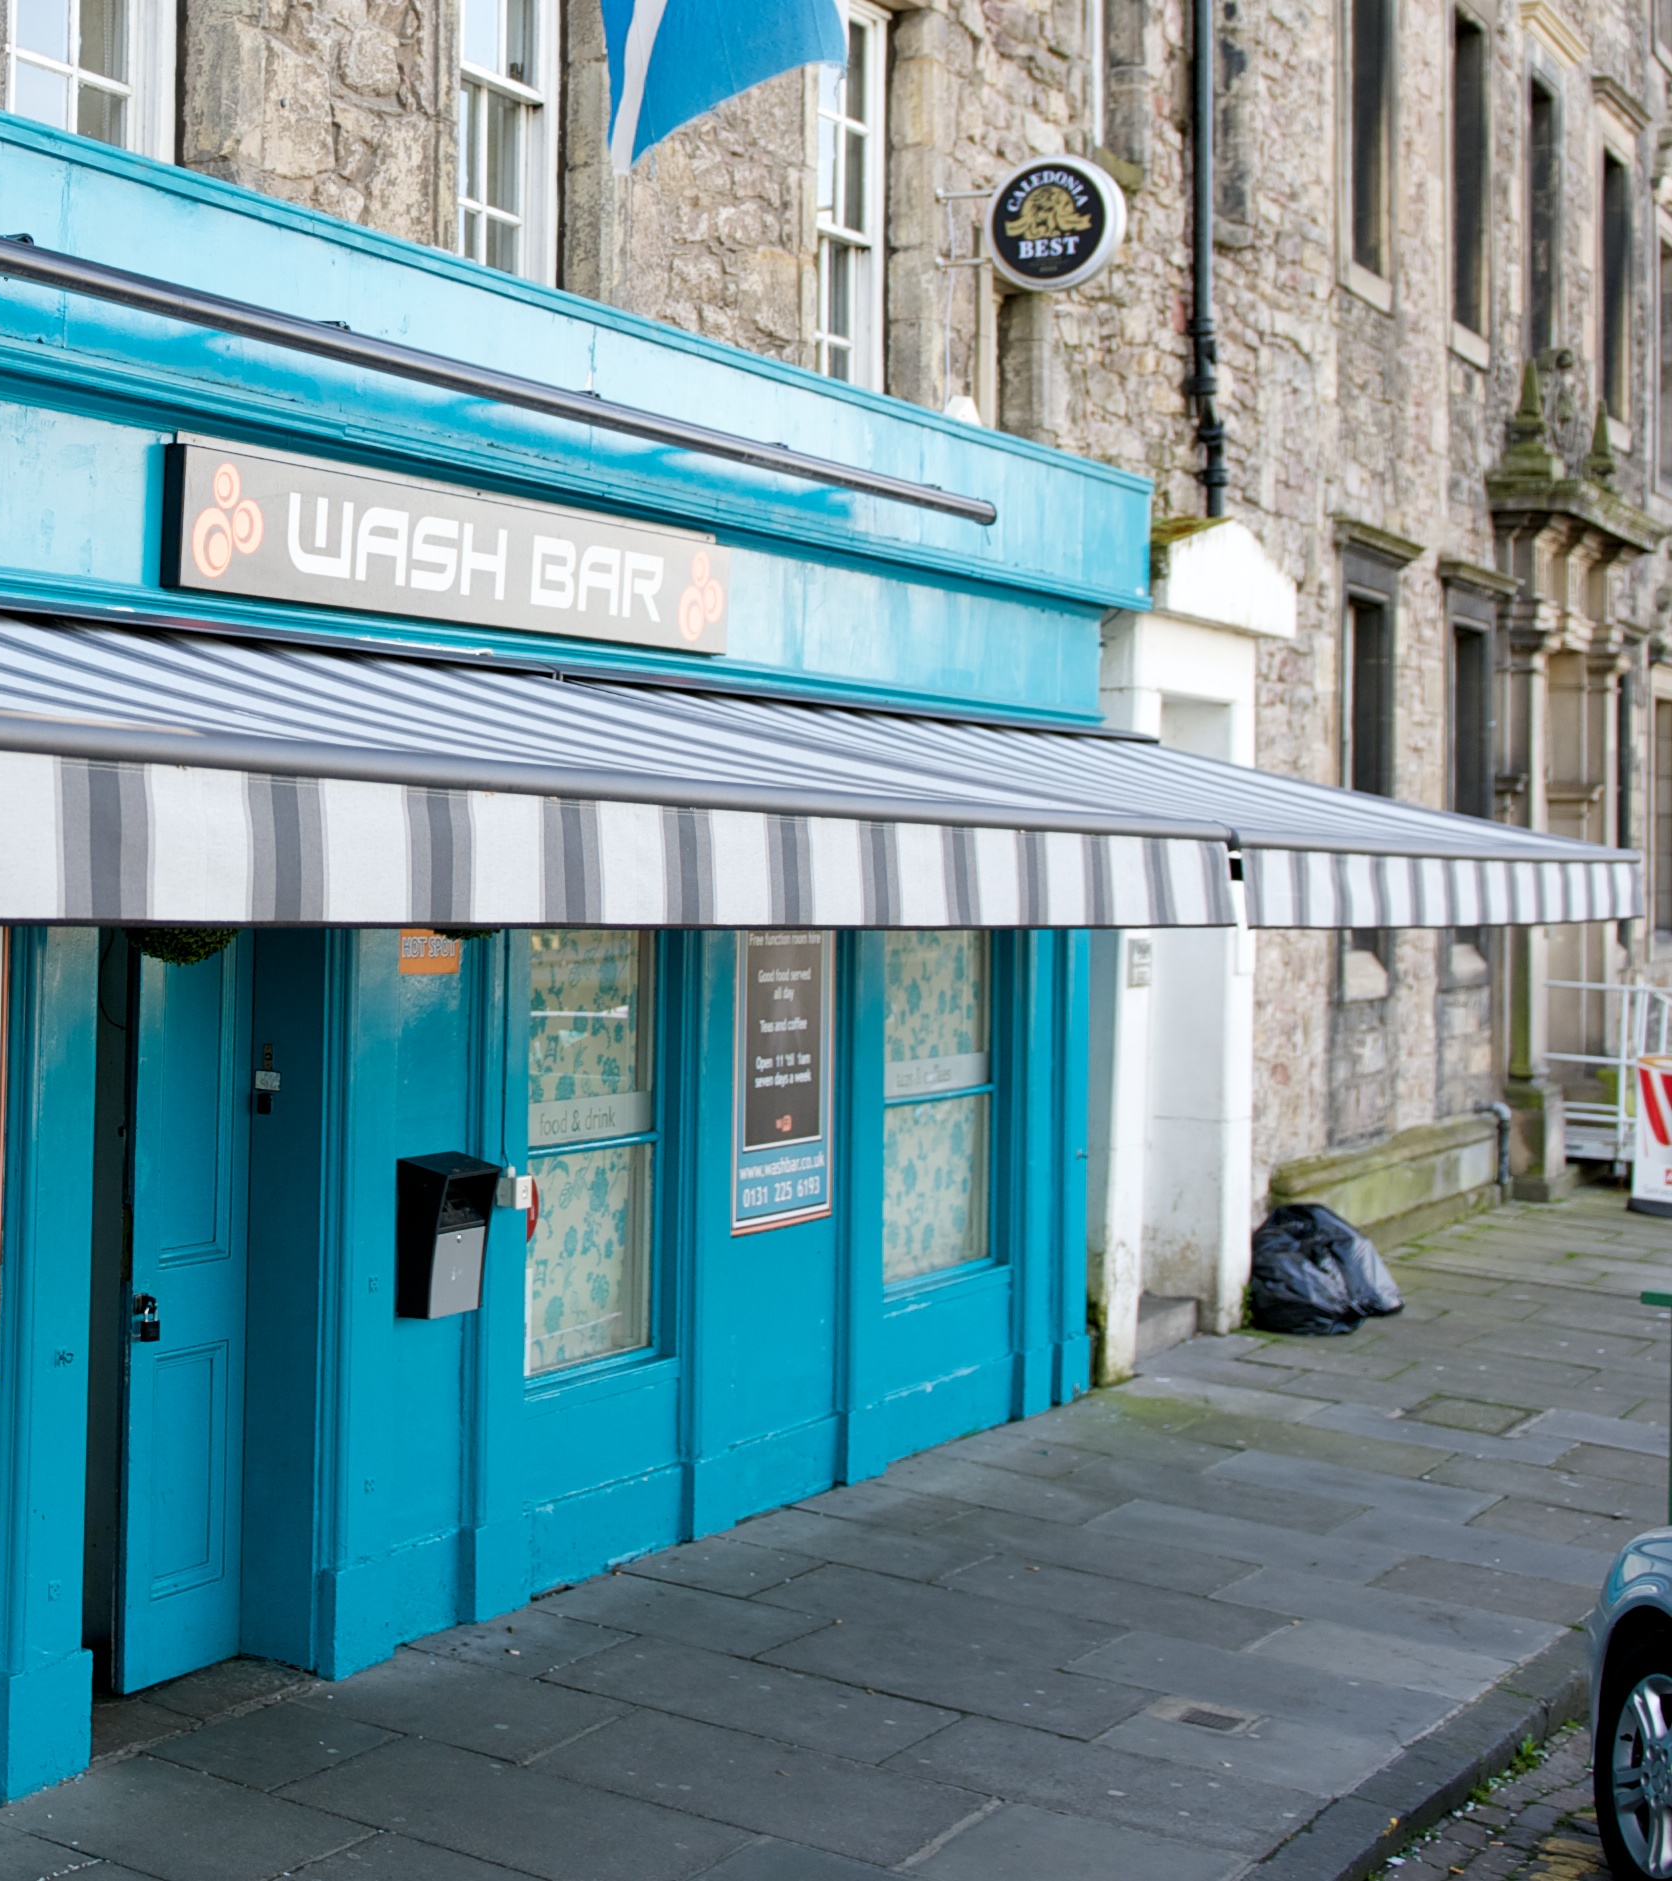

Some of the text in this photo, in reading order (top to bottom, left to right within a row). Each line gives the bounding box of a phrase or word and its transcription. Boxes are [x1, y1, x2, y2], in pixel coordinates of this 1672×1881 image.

[1006, 170, 1089, 212] CALEDONIA
[1018, 236, 1080, 259] BEST
[287, 492, 664, 622] WASH BAR
[402, 936, 457, 958] HOT SPOT
[749, 933, 764, 947] Free
[765, 932, 791, 946] function
[758, 967, 811, 983] Good food served
[783, 986, 795, 1001] day
[759, 1017, 807, 1033] Teas and coffee
[756, 1056, 773, 1072] Open
[776, 1054, 783, 1067] 11
[755, 1076, 773, 1088] seven
[774, 1072, 788, 1087] days
[795, 1068, 811, 1083] week
[539, 1105, 616, 1136] food & drink
[738, 1151, 825, 1180] www.washbar.co.uk
[743, 1175, 820, 1208] 0131 225 6193
